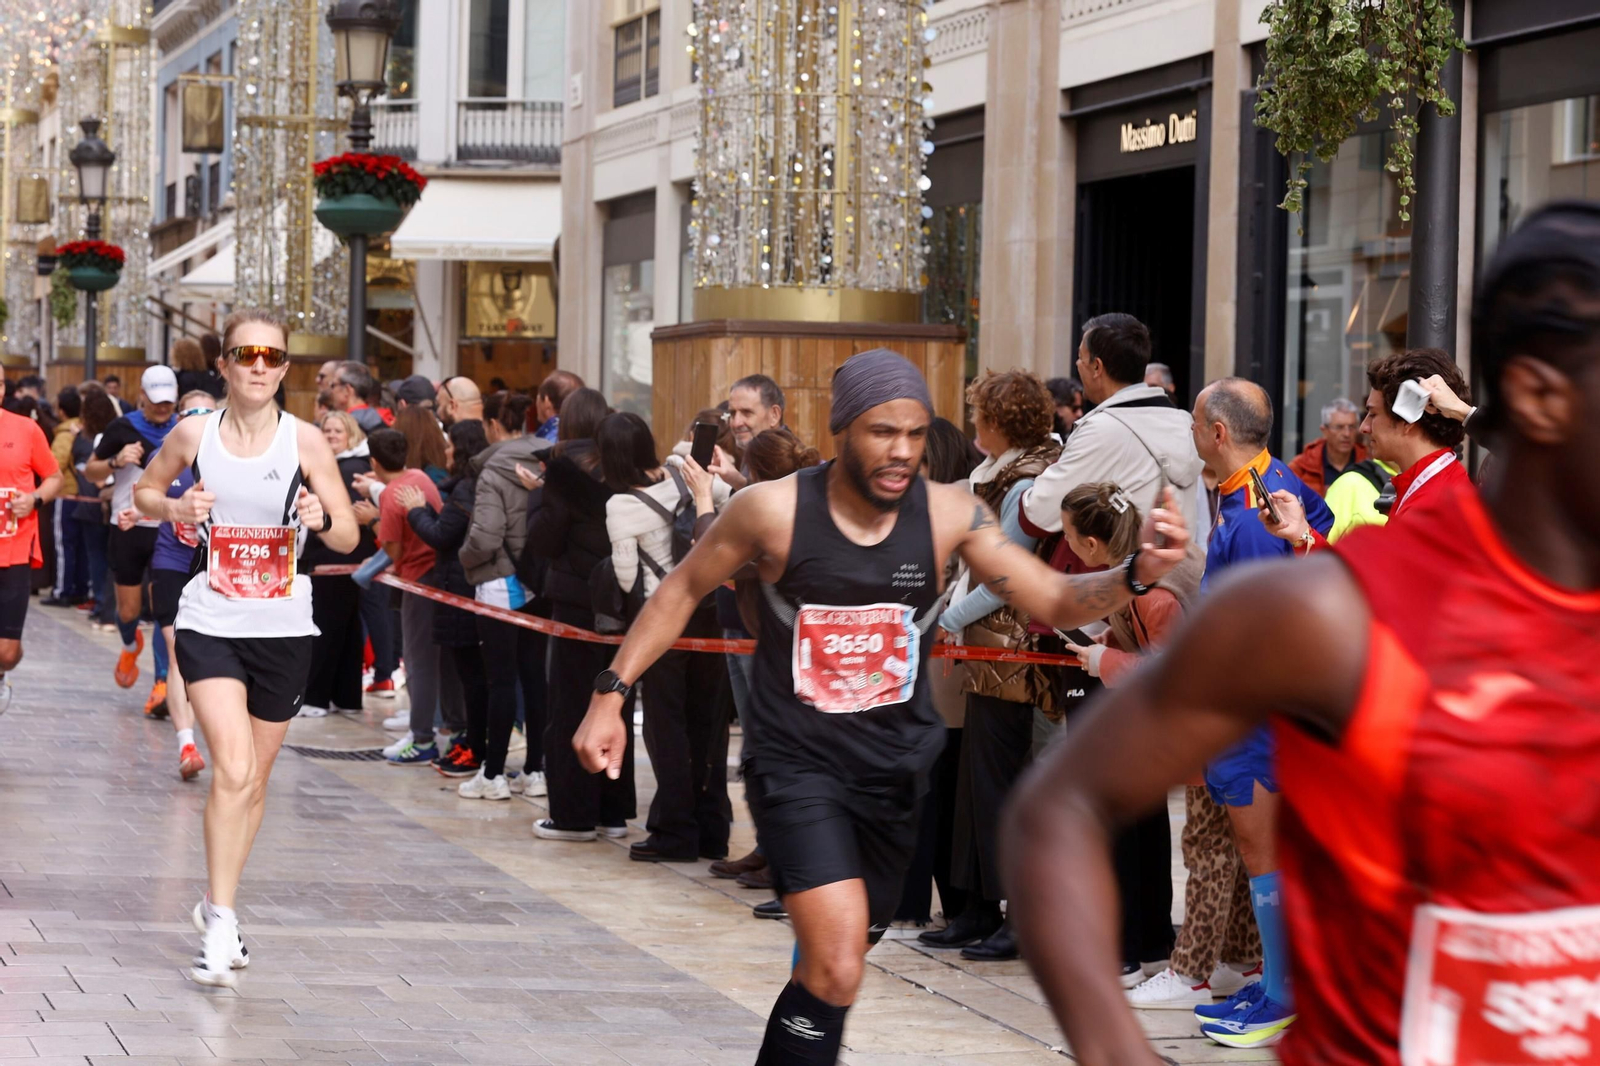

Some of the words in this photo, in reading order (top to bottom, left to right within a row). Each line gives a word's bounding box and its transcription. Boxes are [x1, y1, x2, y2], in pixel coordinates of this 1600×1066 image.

[1121, 118, 1166, 153] Massimo
[1168, 109, 1197, 144] Dutti
[231, 527, 283, 539] GENERALI
[228, 543, 270, 559] 7296
[823, 633, 884, 655] 3650
[1066, 688, 1085, 698] FILA
